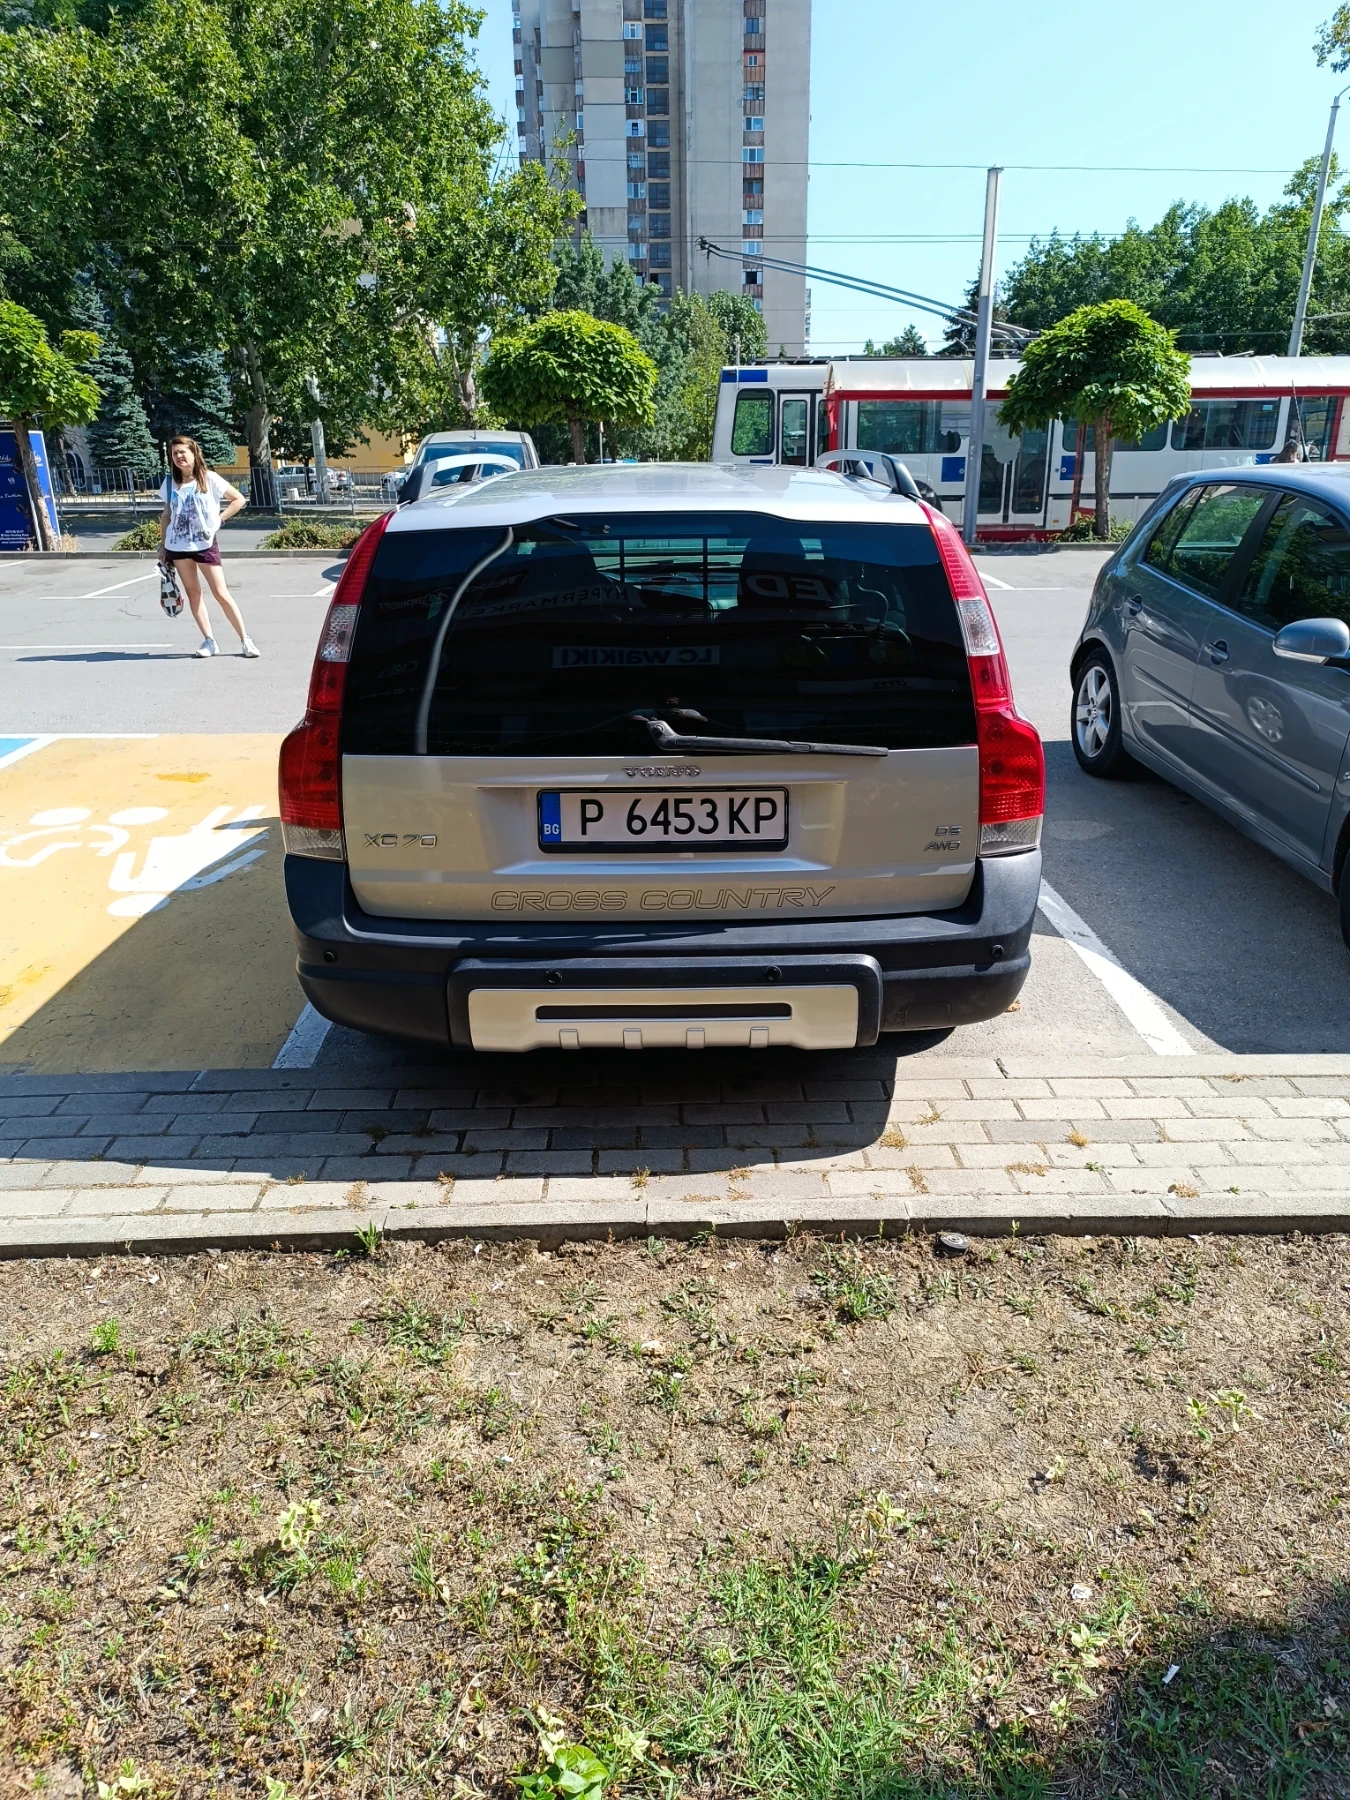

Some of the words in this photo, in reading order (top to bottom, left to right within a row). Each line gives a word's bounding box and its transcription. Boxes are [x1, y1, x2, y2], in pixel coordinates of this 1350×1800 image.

[621, 765, 701, 778] VOLVO
[580, 798, 604, 836] P
[626, 798, 719, 836] 6453
[728, 797, 778, 835] KP
[543, 823, 560, 835] BG
[935, 825, 962, 836] D5
[924, 840, 961, 852] AWD
[490, 890, 628, 911] CROSS
[639, 886, 835, 910] COUNTRY
